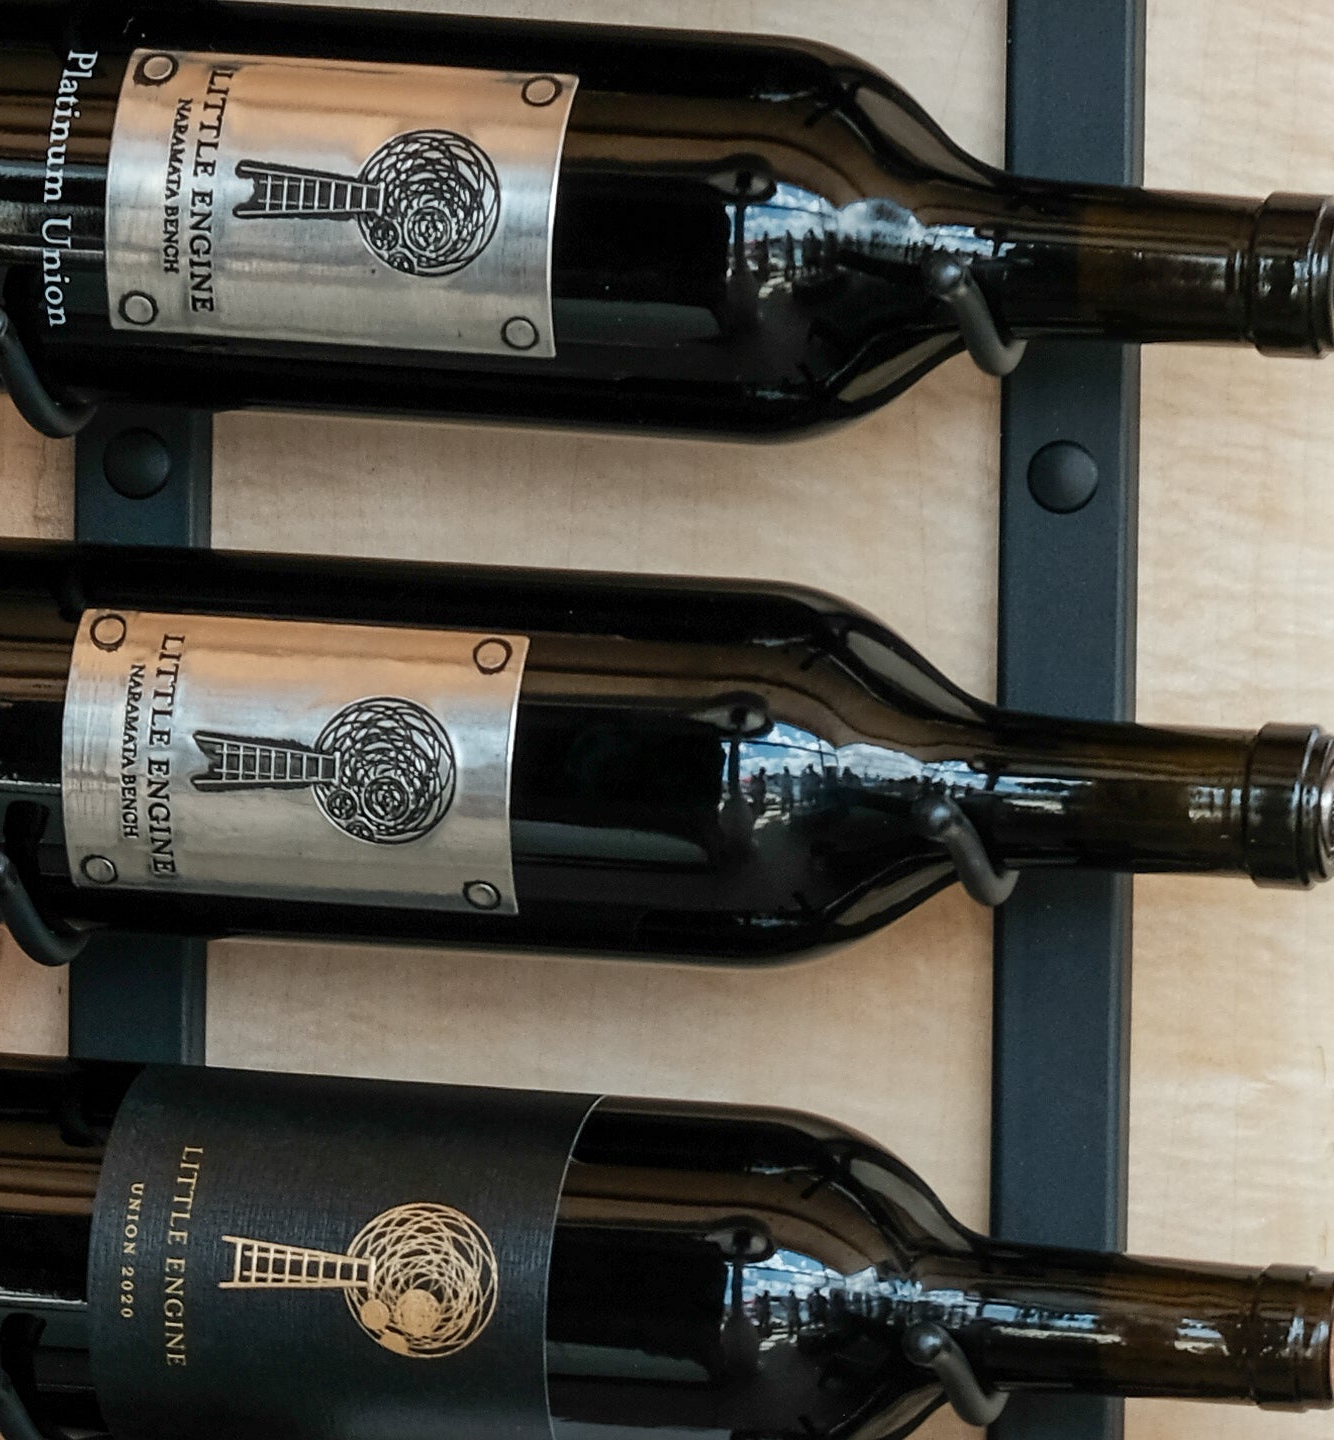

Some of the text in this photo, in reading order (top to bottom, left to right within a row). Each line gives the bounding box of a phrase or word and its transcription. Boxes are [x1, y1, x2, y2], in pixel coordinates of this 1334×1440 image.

[41, 50, 98, 327] Platinum Union
[163, 98, 193, 274] NARAMATA BENCH
[189, 69, 233, 313] LITTLE ENGINE
[121, 664, 146, 839] NARAMATA BENCH
[147, 634, 185, 875] LITTLE ENGINE
[120, 1182, 144, 1319] UNION 2020
[163, 1145, 203, 1366] LITTLE ENGINE
